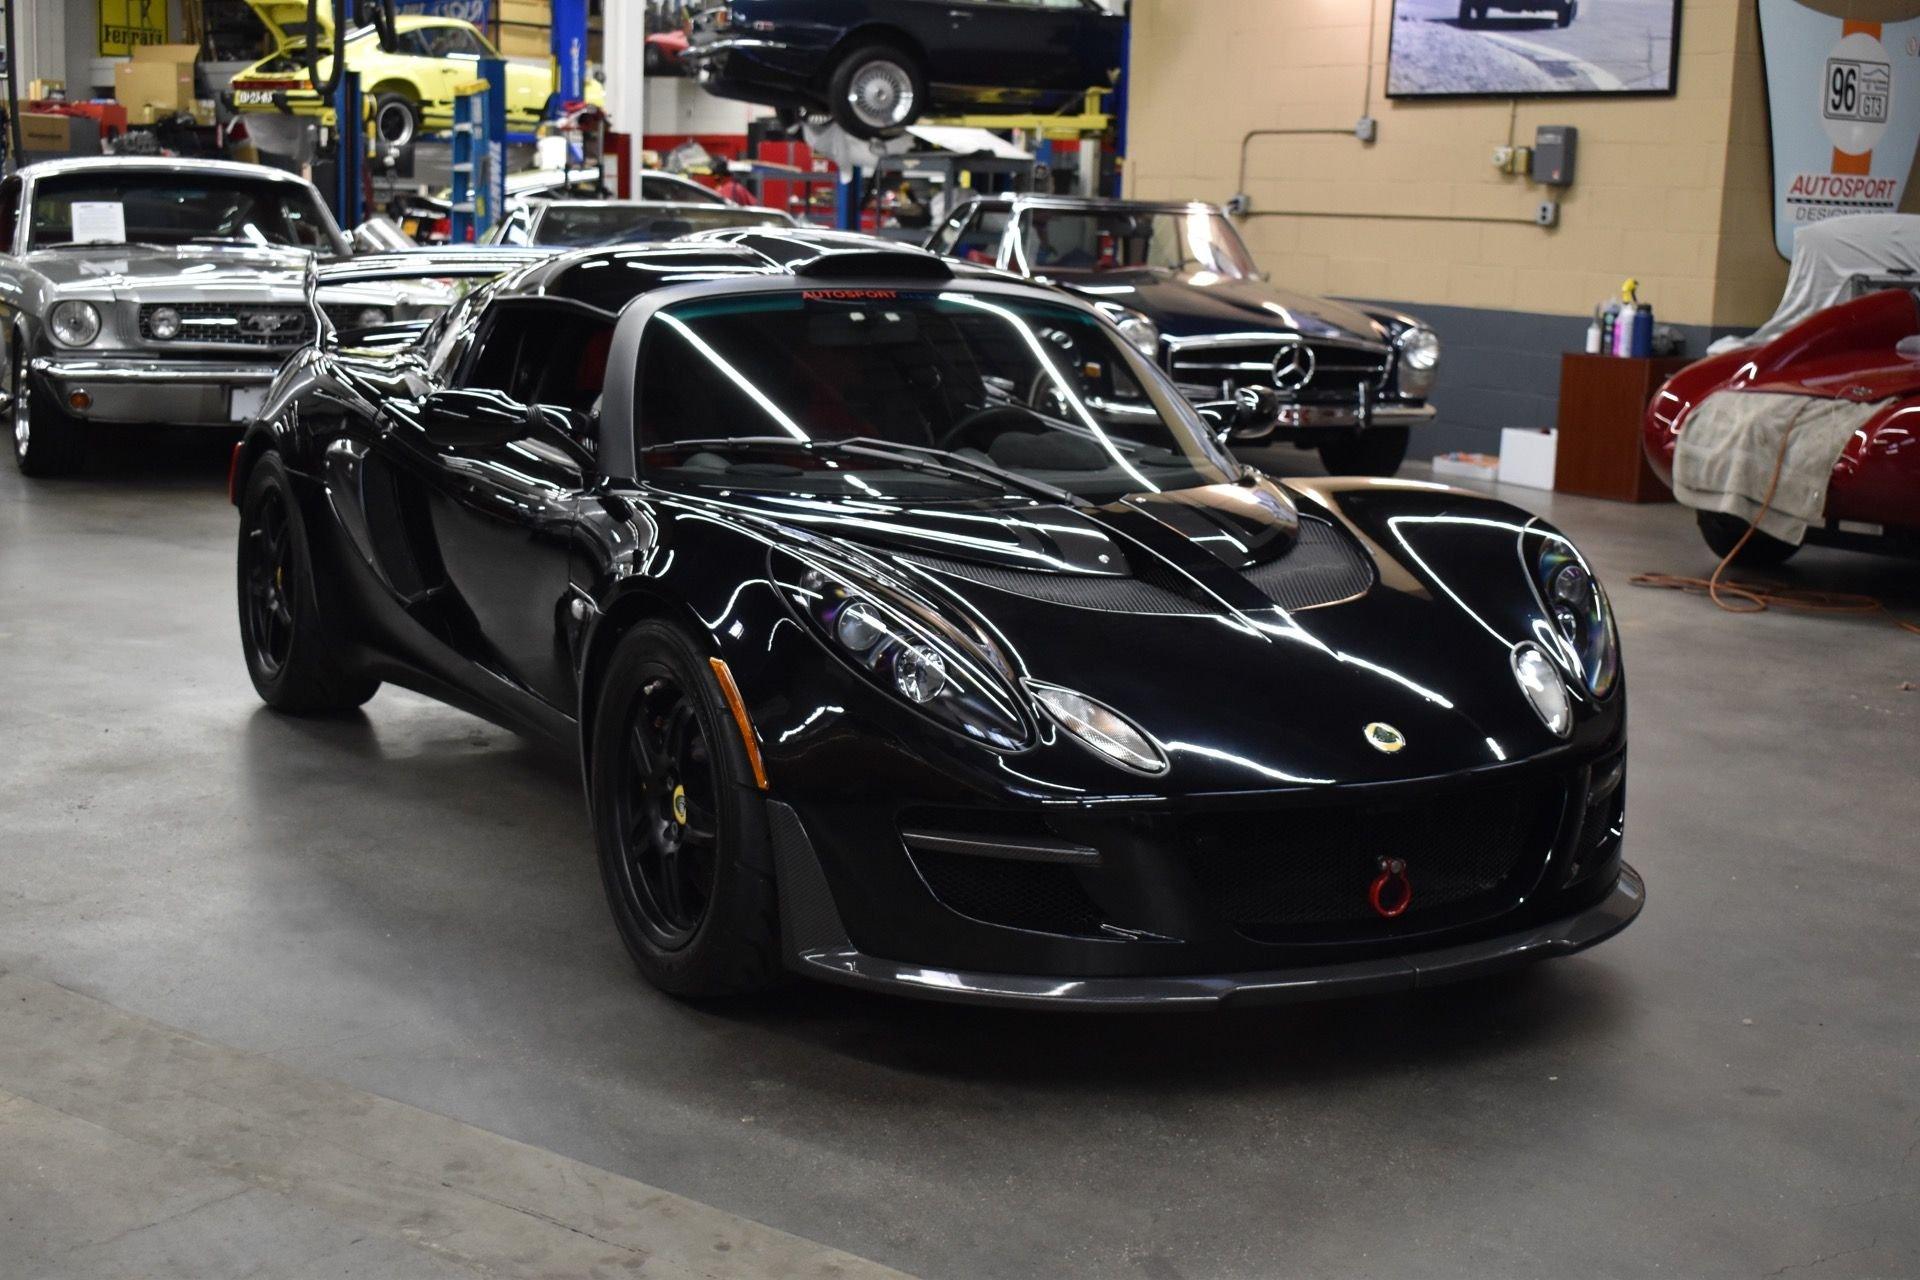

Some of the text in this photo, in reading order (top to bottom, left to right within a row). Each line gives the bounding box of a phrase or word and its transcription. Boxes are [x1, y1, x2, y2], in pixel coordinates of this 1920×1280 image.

[1831, 67, 1857, 112] 96
[1863, 96, 1882, 117] GT3
[1790, 175, 1897, 199] AUTOSPORT
[802, 289, 897, 300] AUTOSPORT
